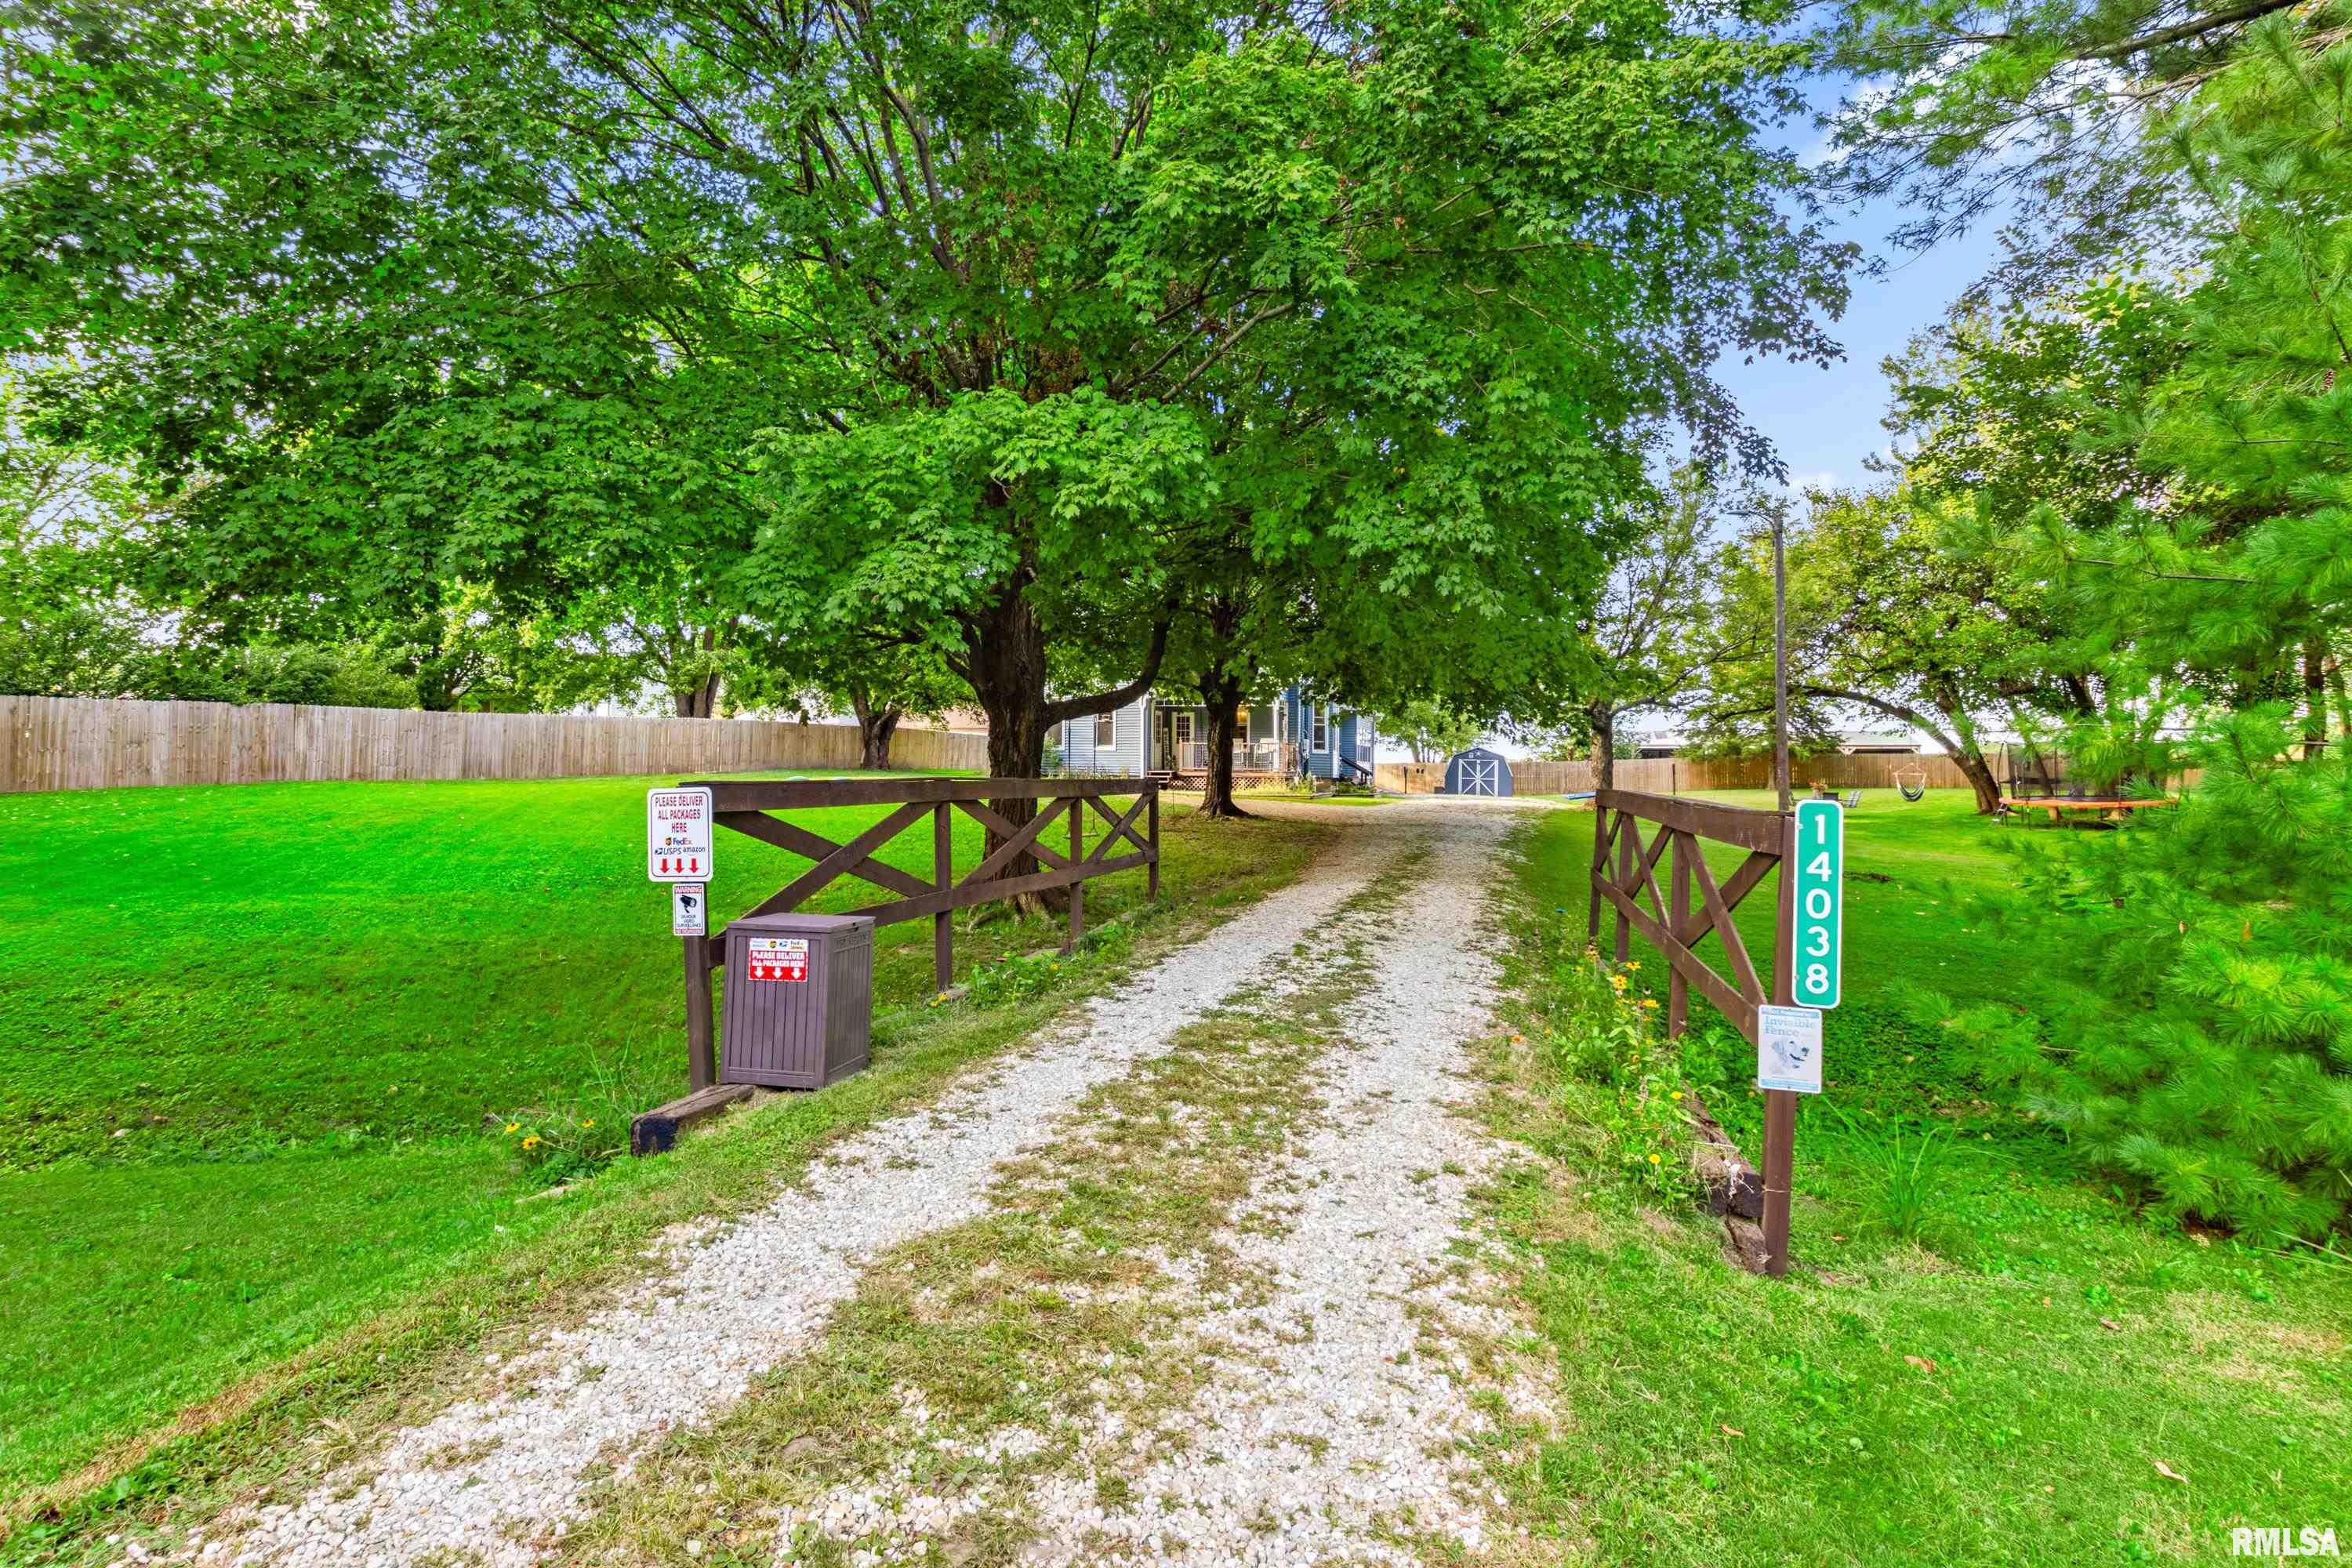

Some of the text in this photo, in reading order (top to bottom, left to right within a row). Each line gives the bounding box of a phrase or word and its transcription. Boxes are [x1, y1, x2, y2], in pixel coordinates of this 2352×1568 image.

[655, 795, 702, 807] PLEASE DELIVER
[658, 809, 701, 820] ALL PACKAGES
[671, 822, 687, 833] HERE
[663, 847, 682, 855] USPS
[1806, 814, 1832, 994] 14038
[752, 951, 805, 960] PLEASE DELIVER
